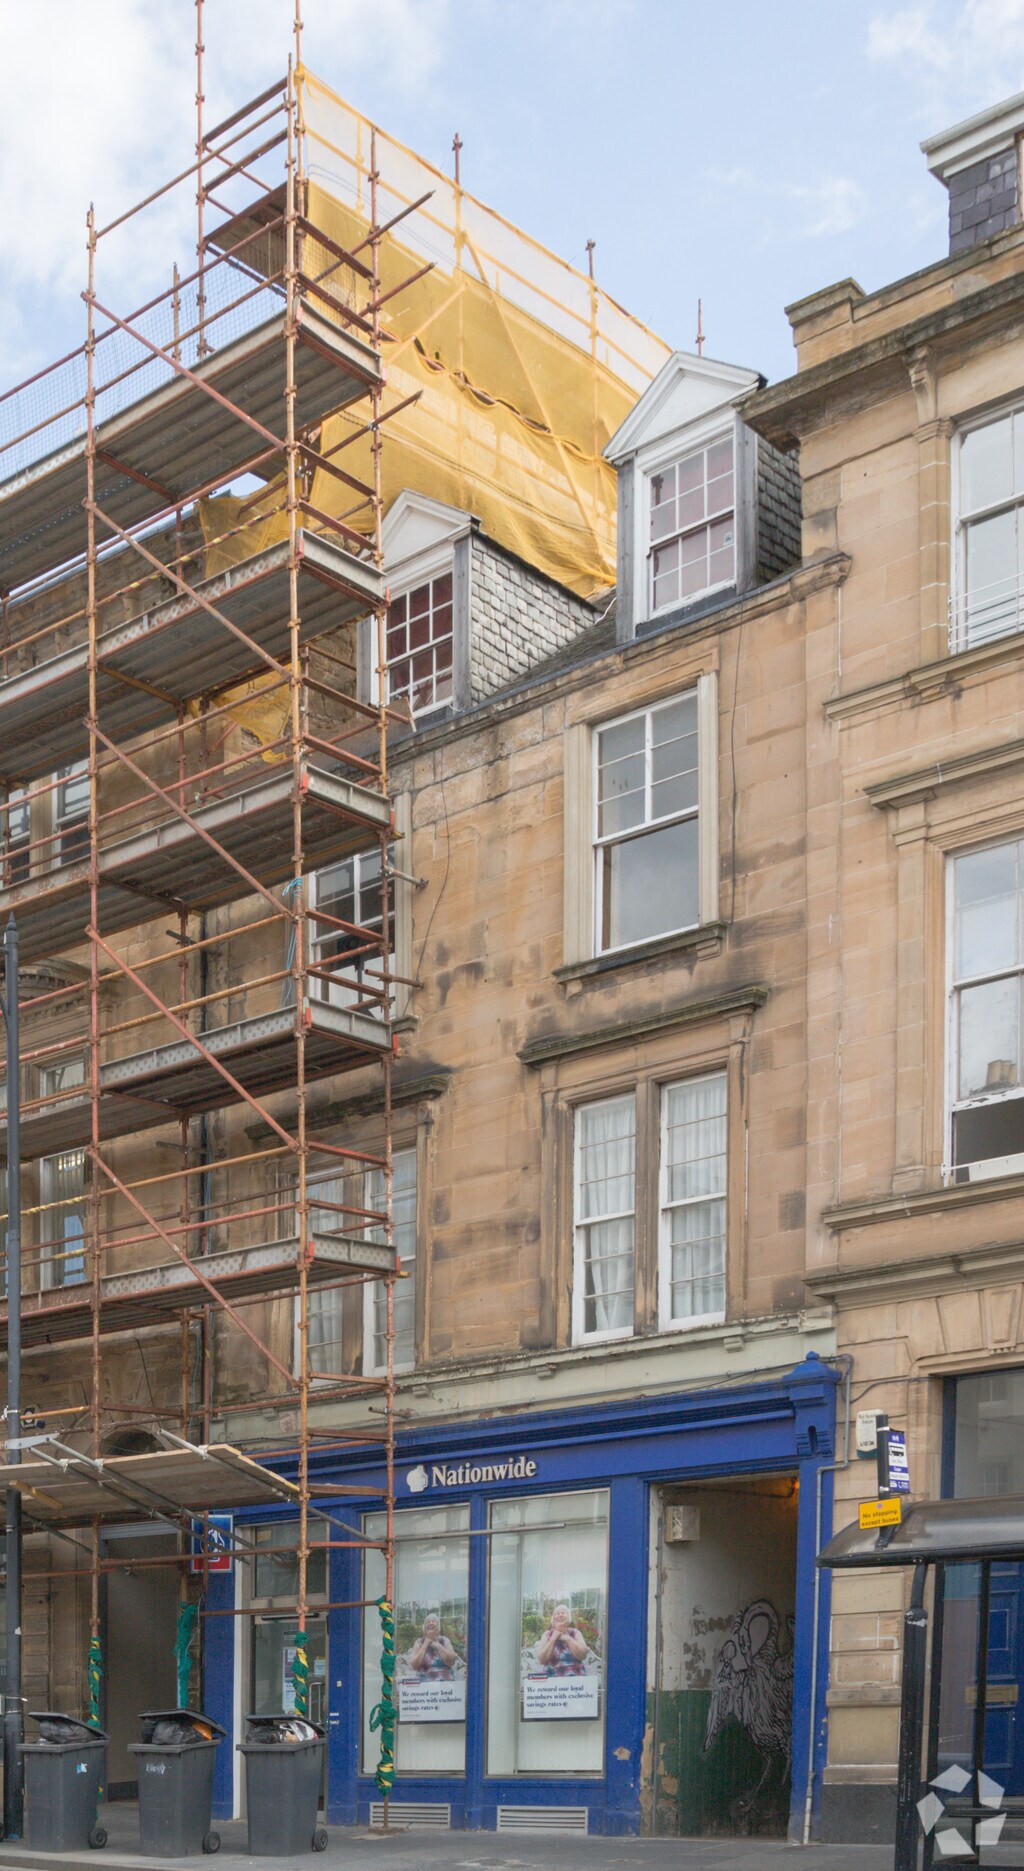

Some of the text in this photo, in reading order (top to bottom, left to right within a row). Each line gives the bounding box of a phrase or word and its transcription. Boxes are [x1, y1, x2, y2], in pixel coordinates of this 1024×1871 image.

[431, 1456, 536, 1488] Nationwide
[872, 1509, 898, 1518] stopping
[861, 1519, 881, 1527] except
